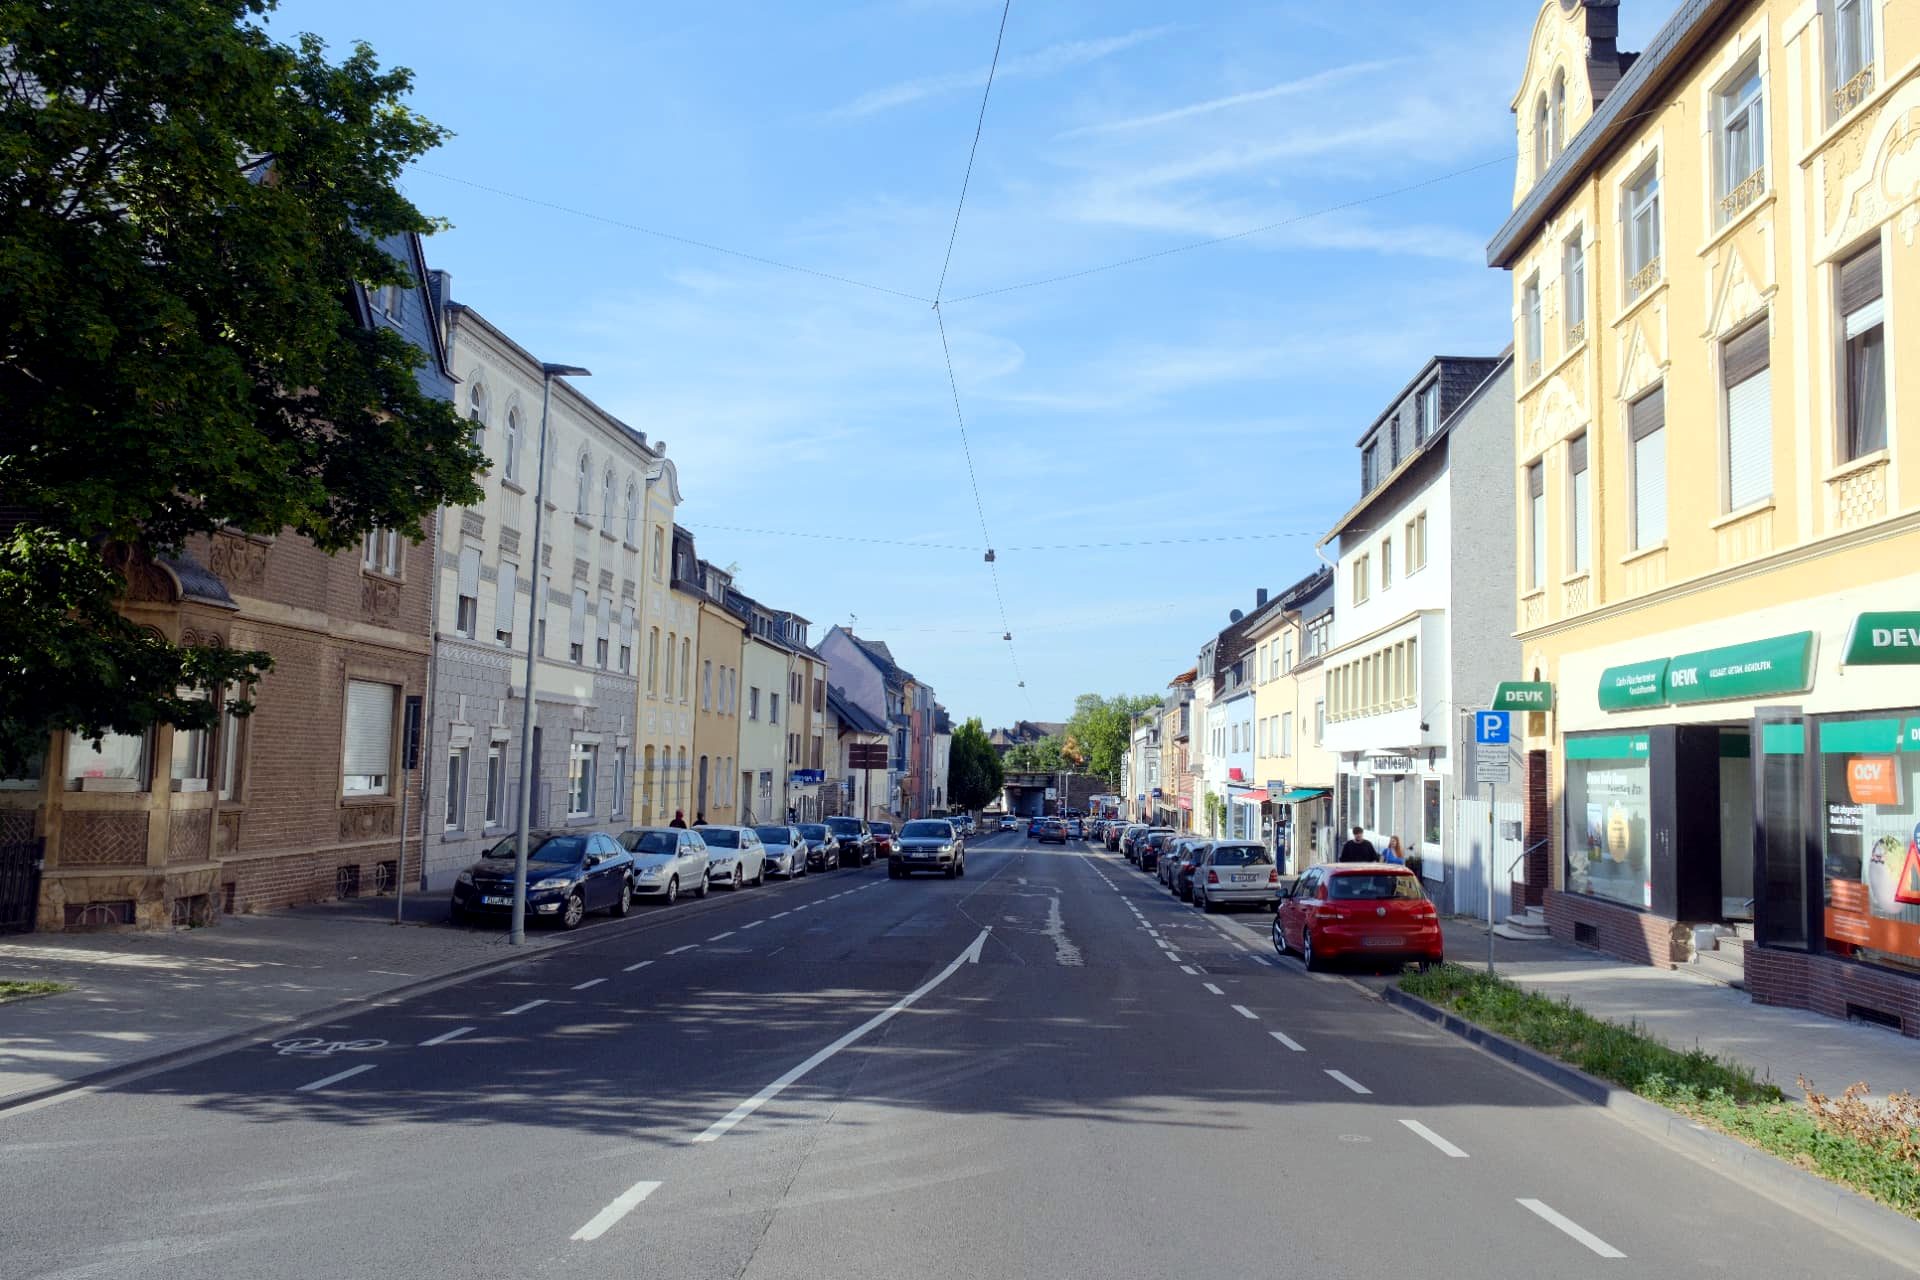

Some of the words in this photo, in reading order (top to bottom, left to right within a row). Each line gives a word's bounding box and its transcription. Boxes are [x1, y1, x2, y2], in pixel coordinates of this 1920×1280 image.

[1671, 667, 1698, 687] DEVK
[1505, 691, 1543, 702] DEVK
[1483, 715, 1502, 739] P
